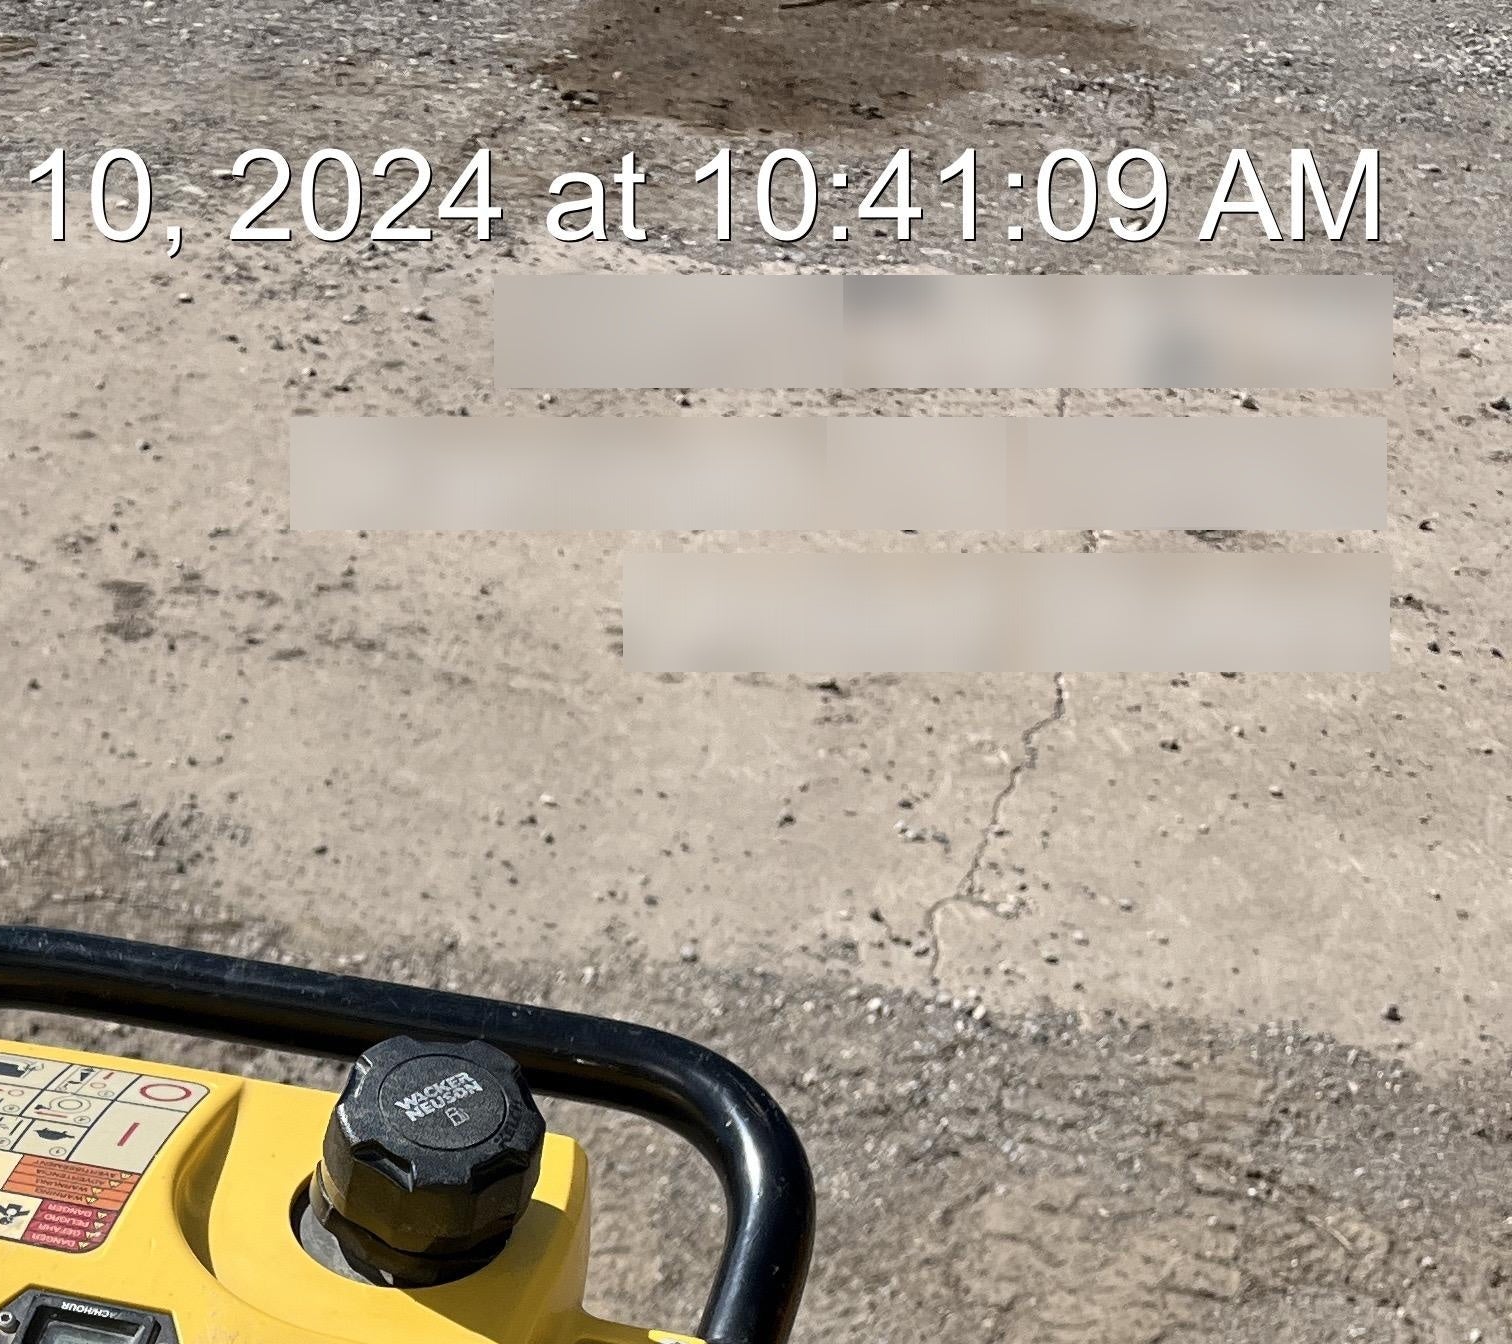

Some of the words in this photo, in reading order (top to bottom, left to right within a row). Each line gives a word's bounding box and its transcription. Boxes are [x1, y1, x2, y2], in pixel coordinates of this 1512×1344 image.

[395, 1071, 473, 1110] WACKER
[405, 1080, 483, 1122] NEUSON
[35, 1187, 83, 1201] WARNING
[48, 1204, 92, 1218] DANGER
[44, 1213, 89, 1227] PELIGRO
[32, 1233, 76, 1247] DANGER
